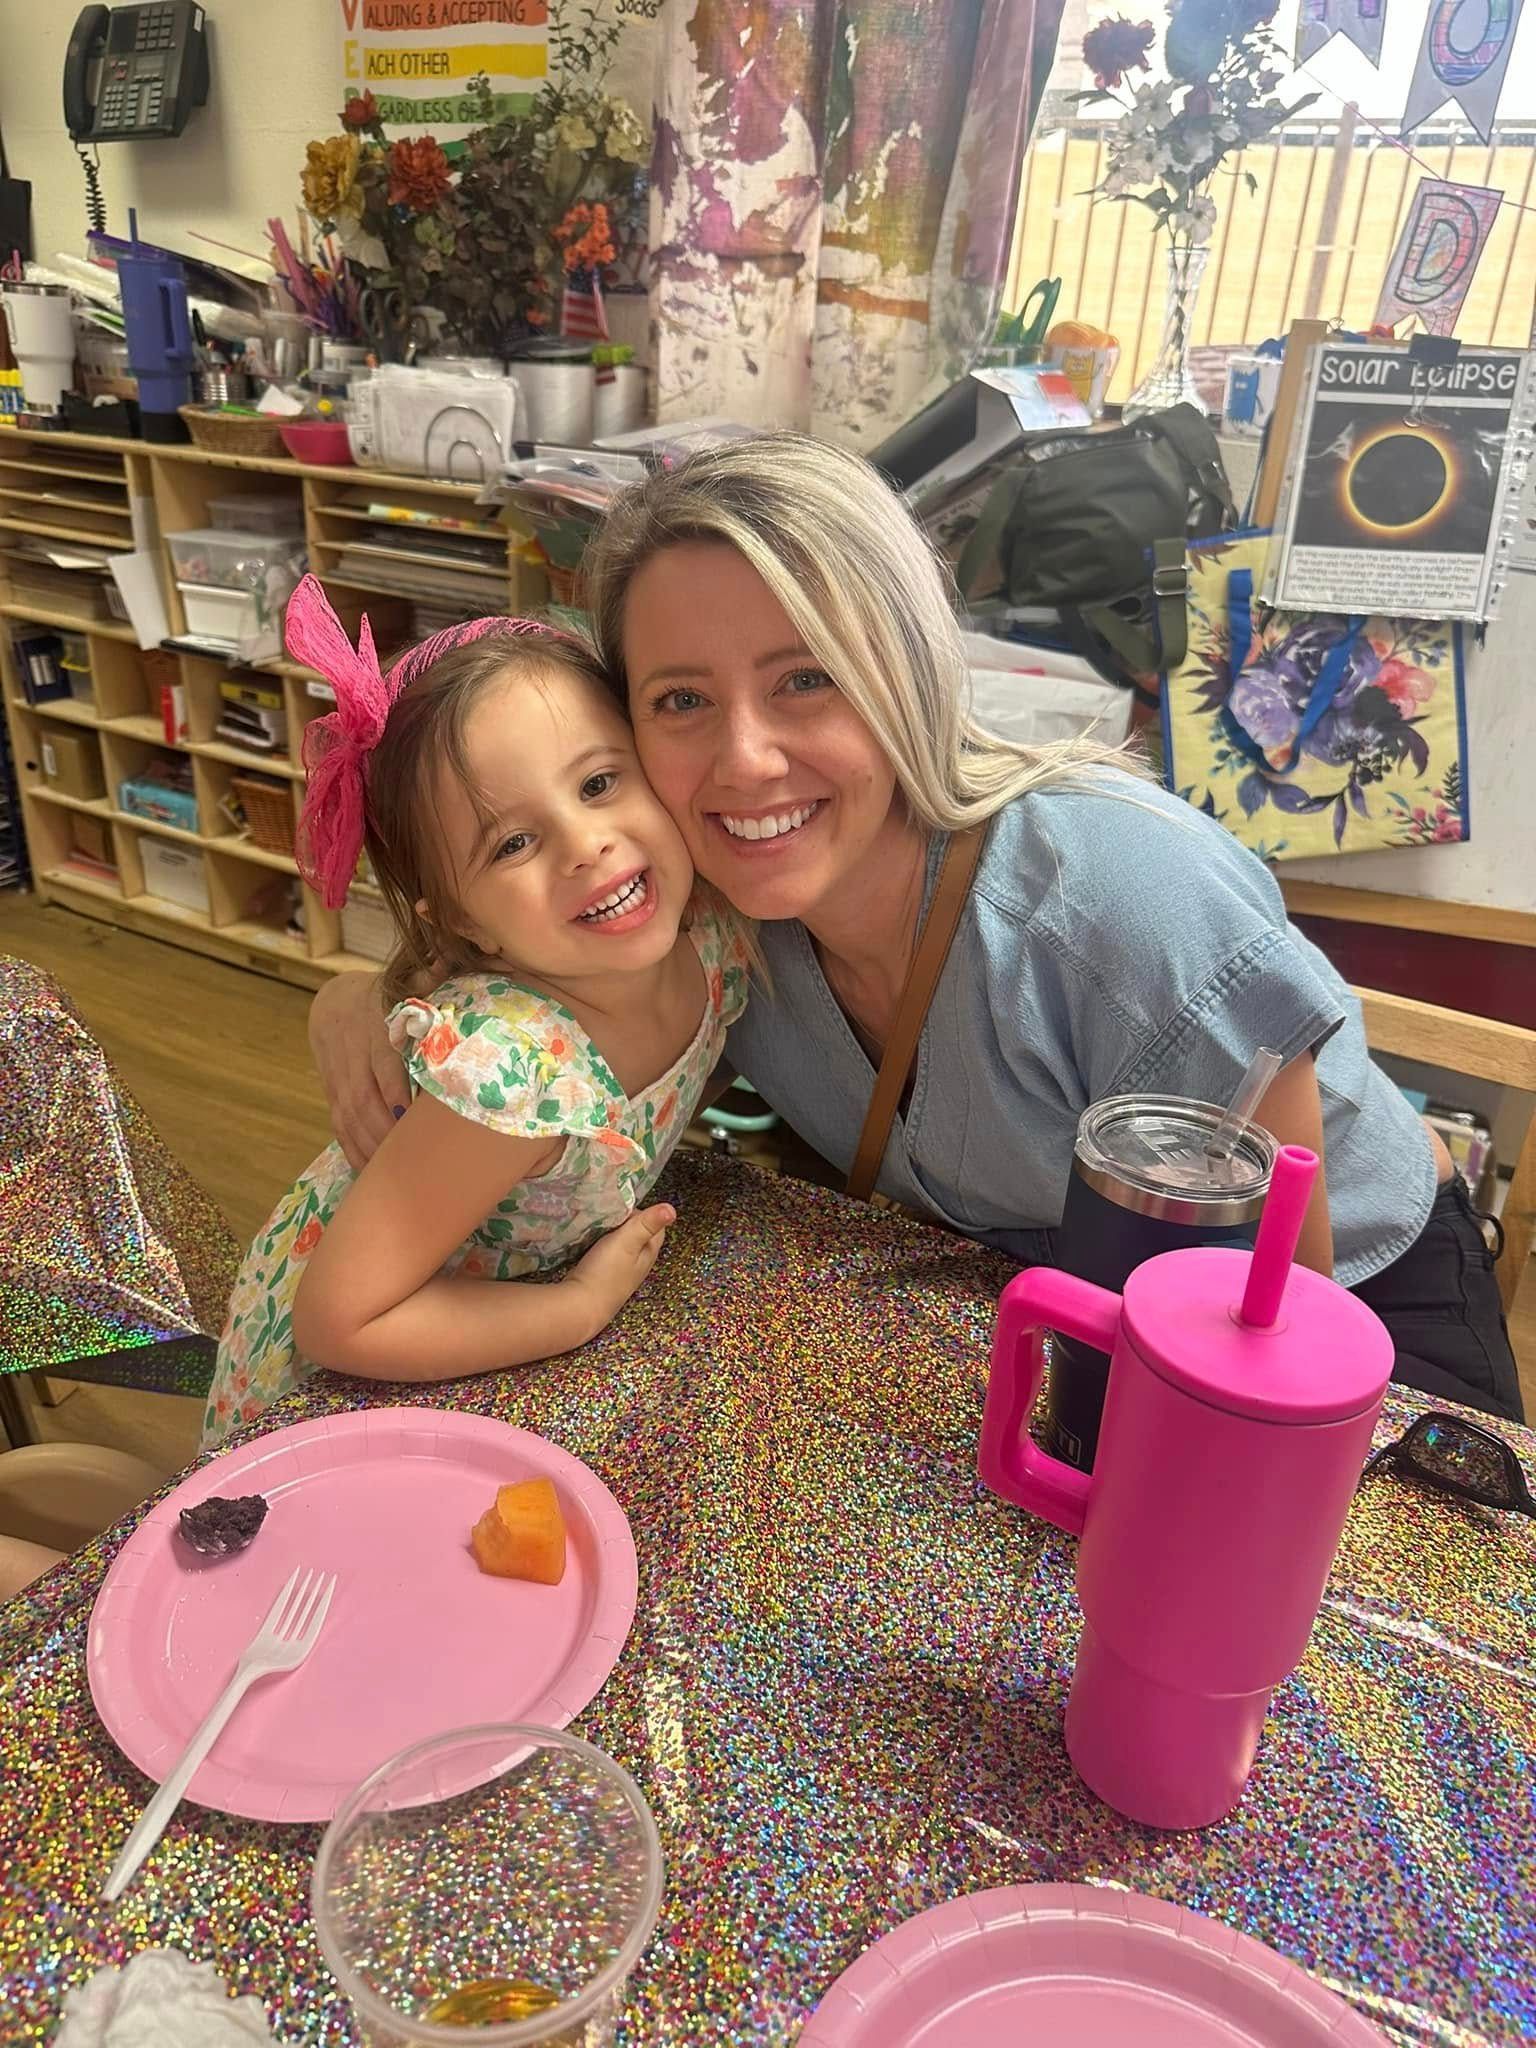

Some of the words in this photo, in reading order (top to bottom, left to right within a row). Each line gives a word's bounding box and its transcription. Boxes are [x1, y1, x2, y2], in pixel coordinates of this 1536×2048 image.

[443, 0, 526, 24] ACCEPTING
[400, 53, 450, 75] OTHER
[379, 102, 450, 123] GARDLESS
[1321, 356, 1400, 385] Solar
[1410, 362, 1517, 391] Eclipse
